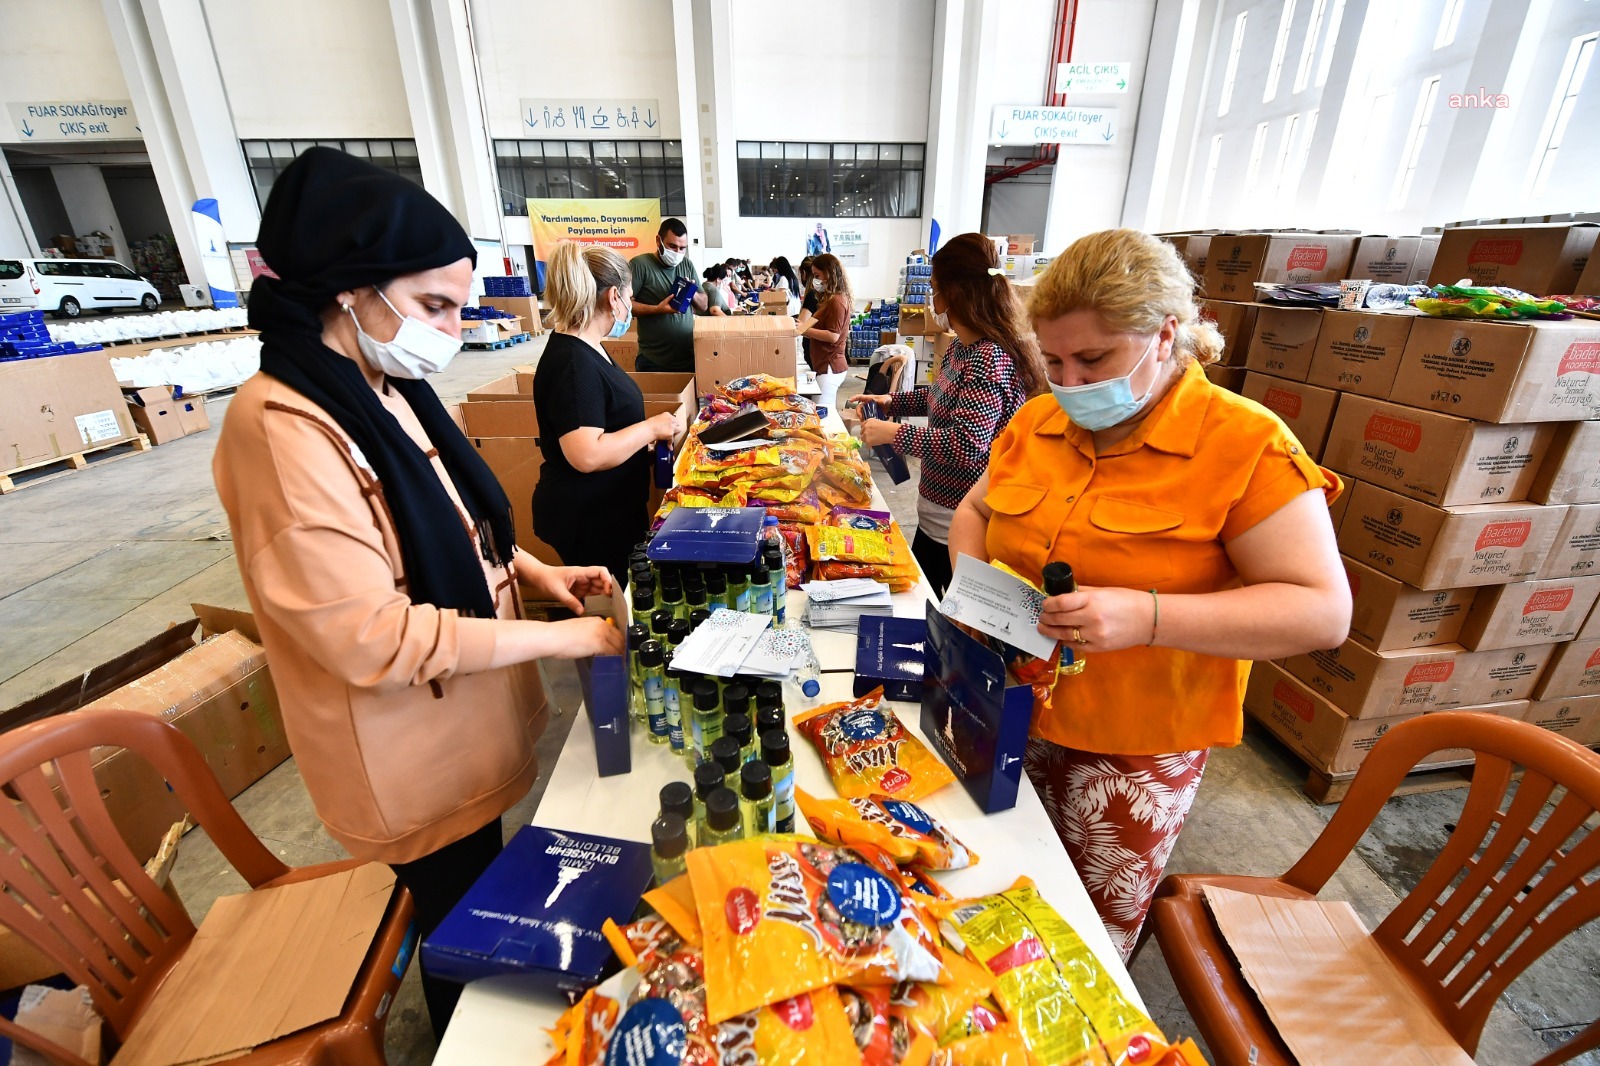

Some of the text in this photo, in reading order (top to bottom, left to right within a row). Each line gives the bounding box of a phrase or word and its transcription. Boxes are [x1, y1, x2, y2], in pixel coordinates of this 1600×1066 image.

[1070, 64, 1118, 76] ACİL ÇIKIŞ
[28, 103, 128, 118] FUAR SOKAĞI foyer
[1012, 110, 1103, 124] FUAR SOKAĞI foyer
[60, 122, 110, 136] ÇIKIŞ exit
[1034, 127, 1078, 139] ÇIKIŞ exit
[541, 215, 650, 224] Yardımlaşma, Dayanışma,
[568, 225, 626, 236] Paylaşma İçin
[1467, 266, 1499, 274] Naturel
[1555, 376, 1590, 387] Naturel
[1549, 394, 1592, 407] Zeytinyağı
[1372, 418, 1415, 438] bademli
[1363, 442, 1396, 460] Naturel
[1360, 456, 1404, 480] Zeytinyağı
[1485, 524, 1526, 538] bademli
[1473, 550, 1506, 560] Naturel
[1469, 563, 1511, 575] Zeytinyağı
[1532, 591, 1569, 604] bademli
[1521, 614, 1550, 624] Naturel
[1516, 626, 1553, 636] Zeytinyağı
[1412, 664, 1449, 676] bademli
[1402, 684, 1432, 695] Naturel
[1400, 696, 1437, 705] Zeytinyağı
[882, 772, 908, 790] kent
[554, 838, 622, 855] BELEDİYESİ
[559, 858, 595, 871] İZMİR
[733, 893, 753, 934] kent
